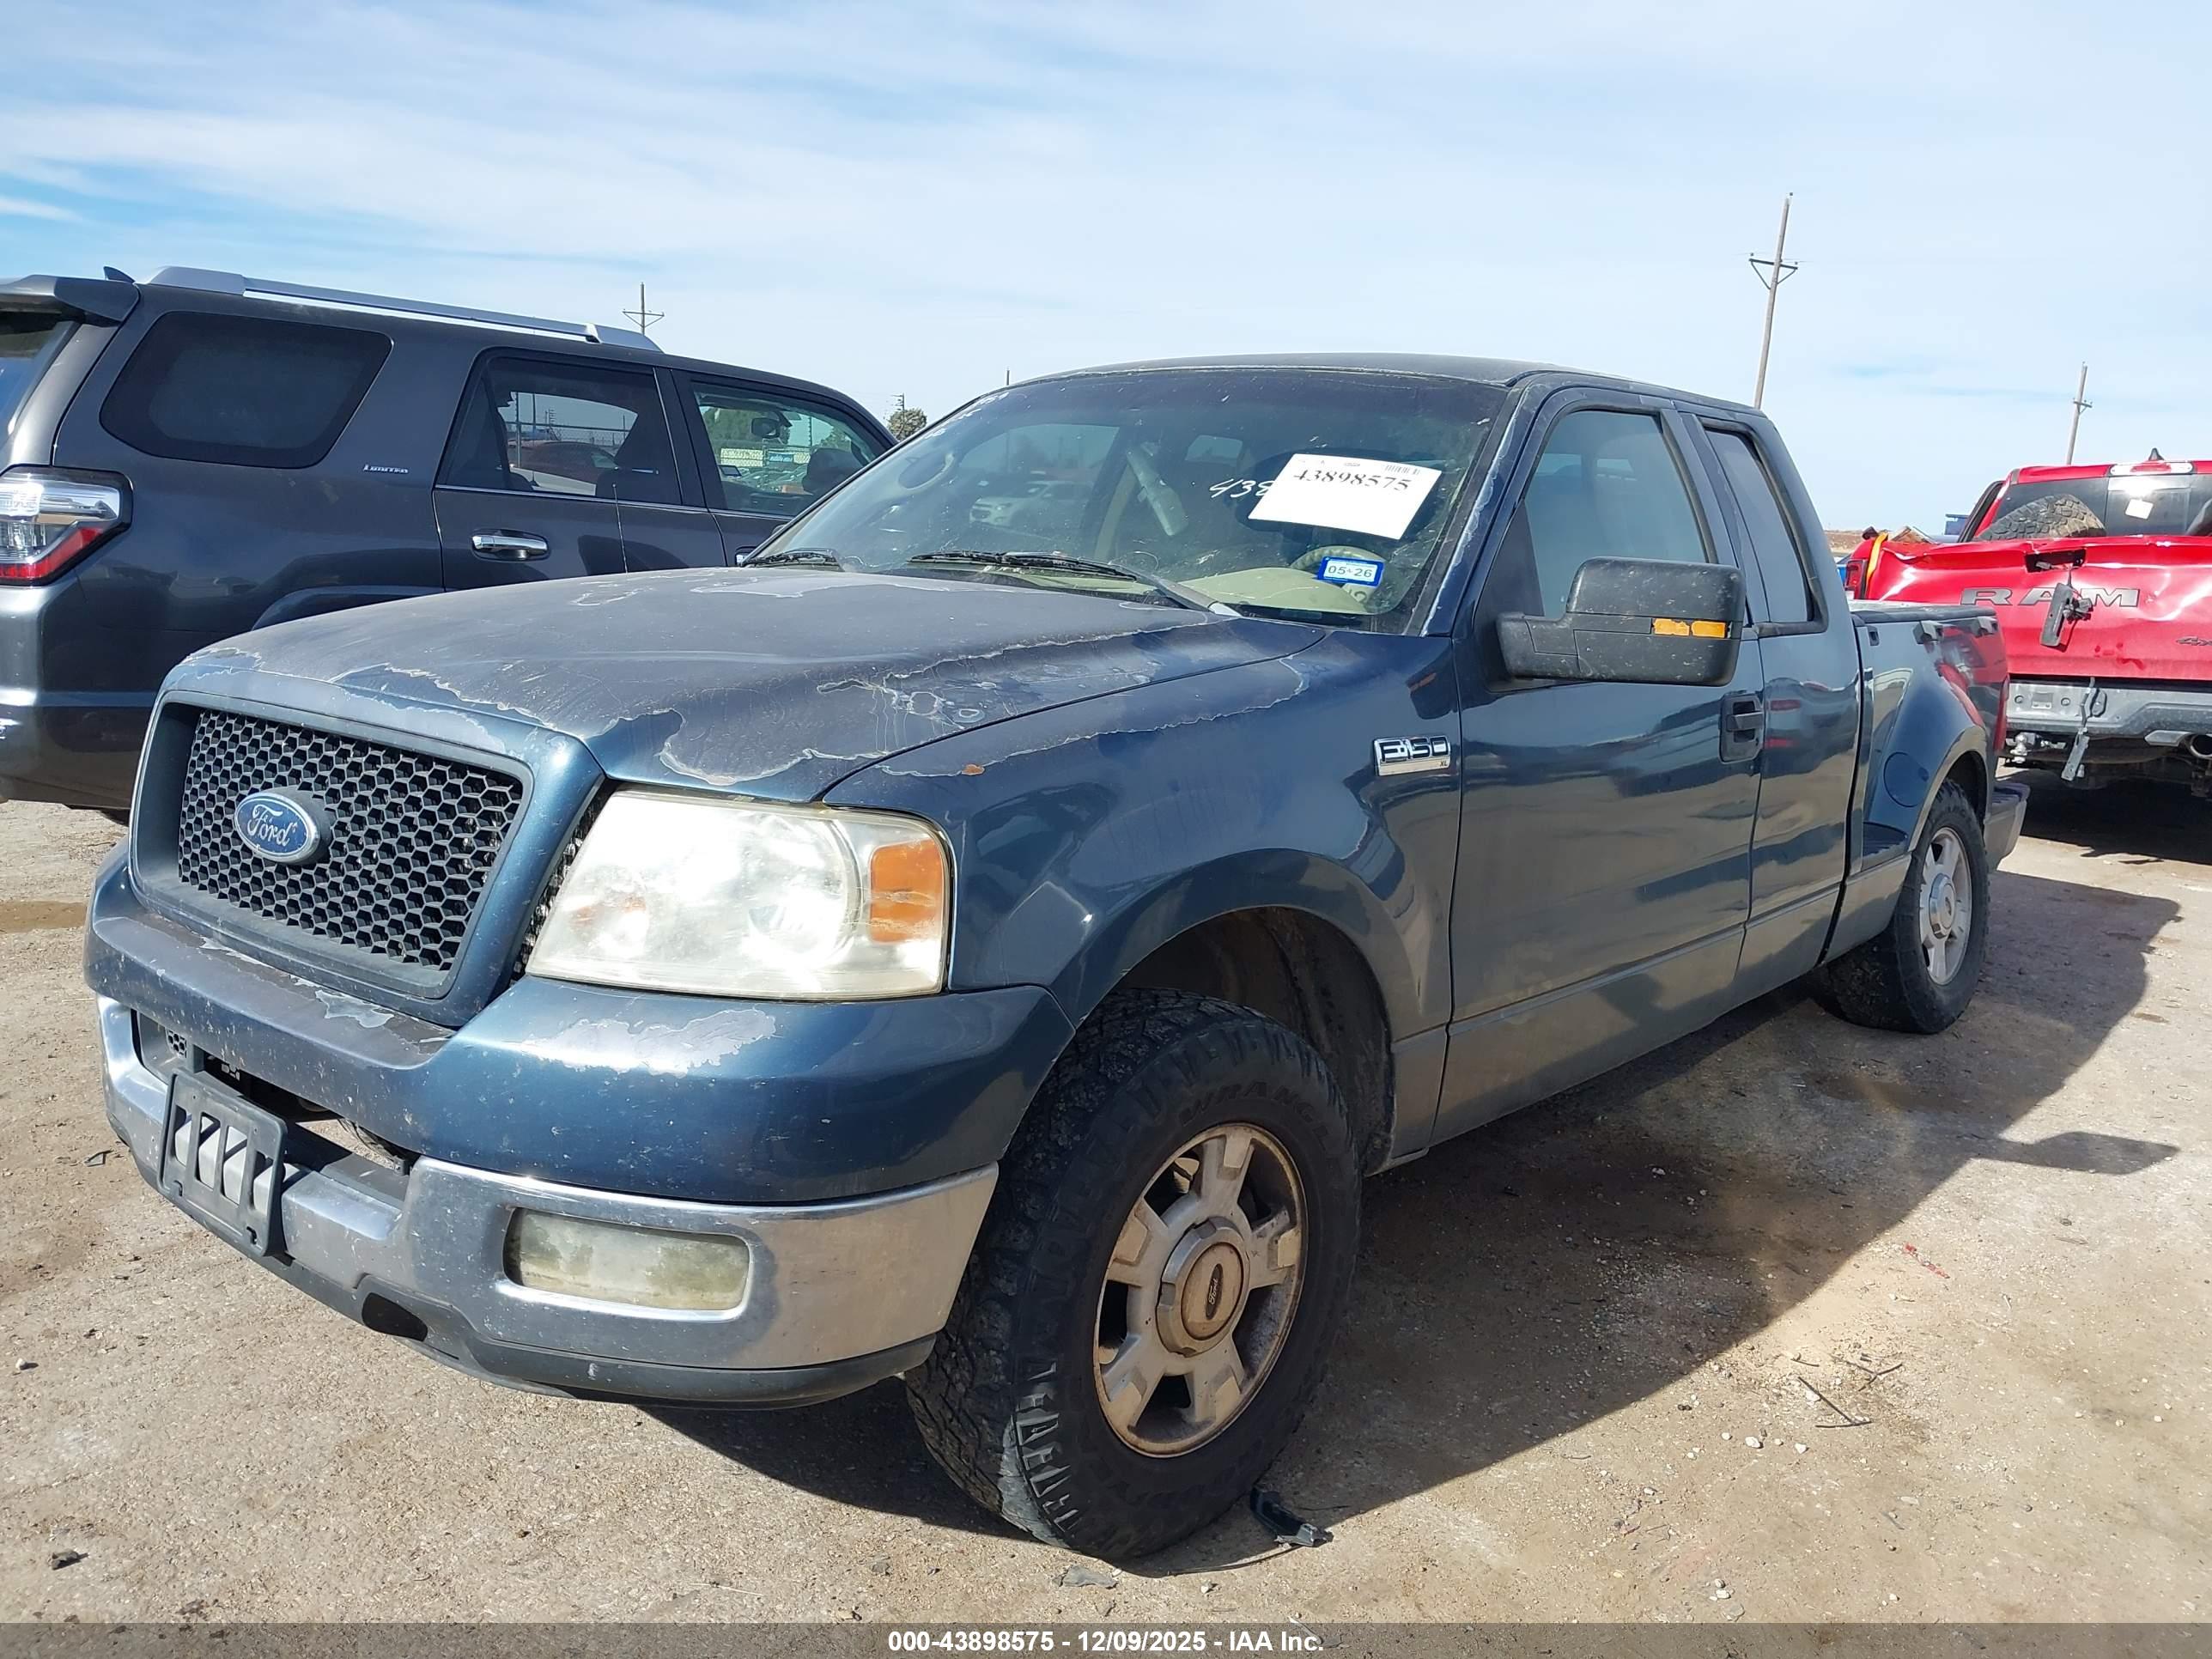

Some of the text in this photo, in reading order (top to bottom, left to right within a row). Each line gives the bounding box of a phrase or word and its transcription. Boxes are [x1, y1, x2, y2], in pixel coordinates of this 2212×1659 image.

[1294, 470, 1412, 490] 43898575
[2175, 636, 2212, 646] 4x
[246, 804, 298, 847] Ford
